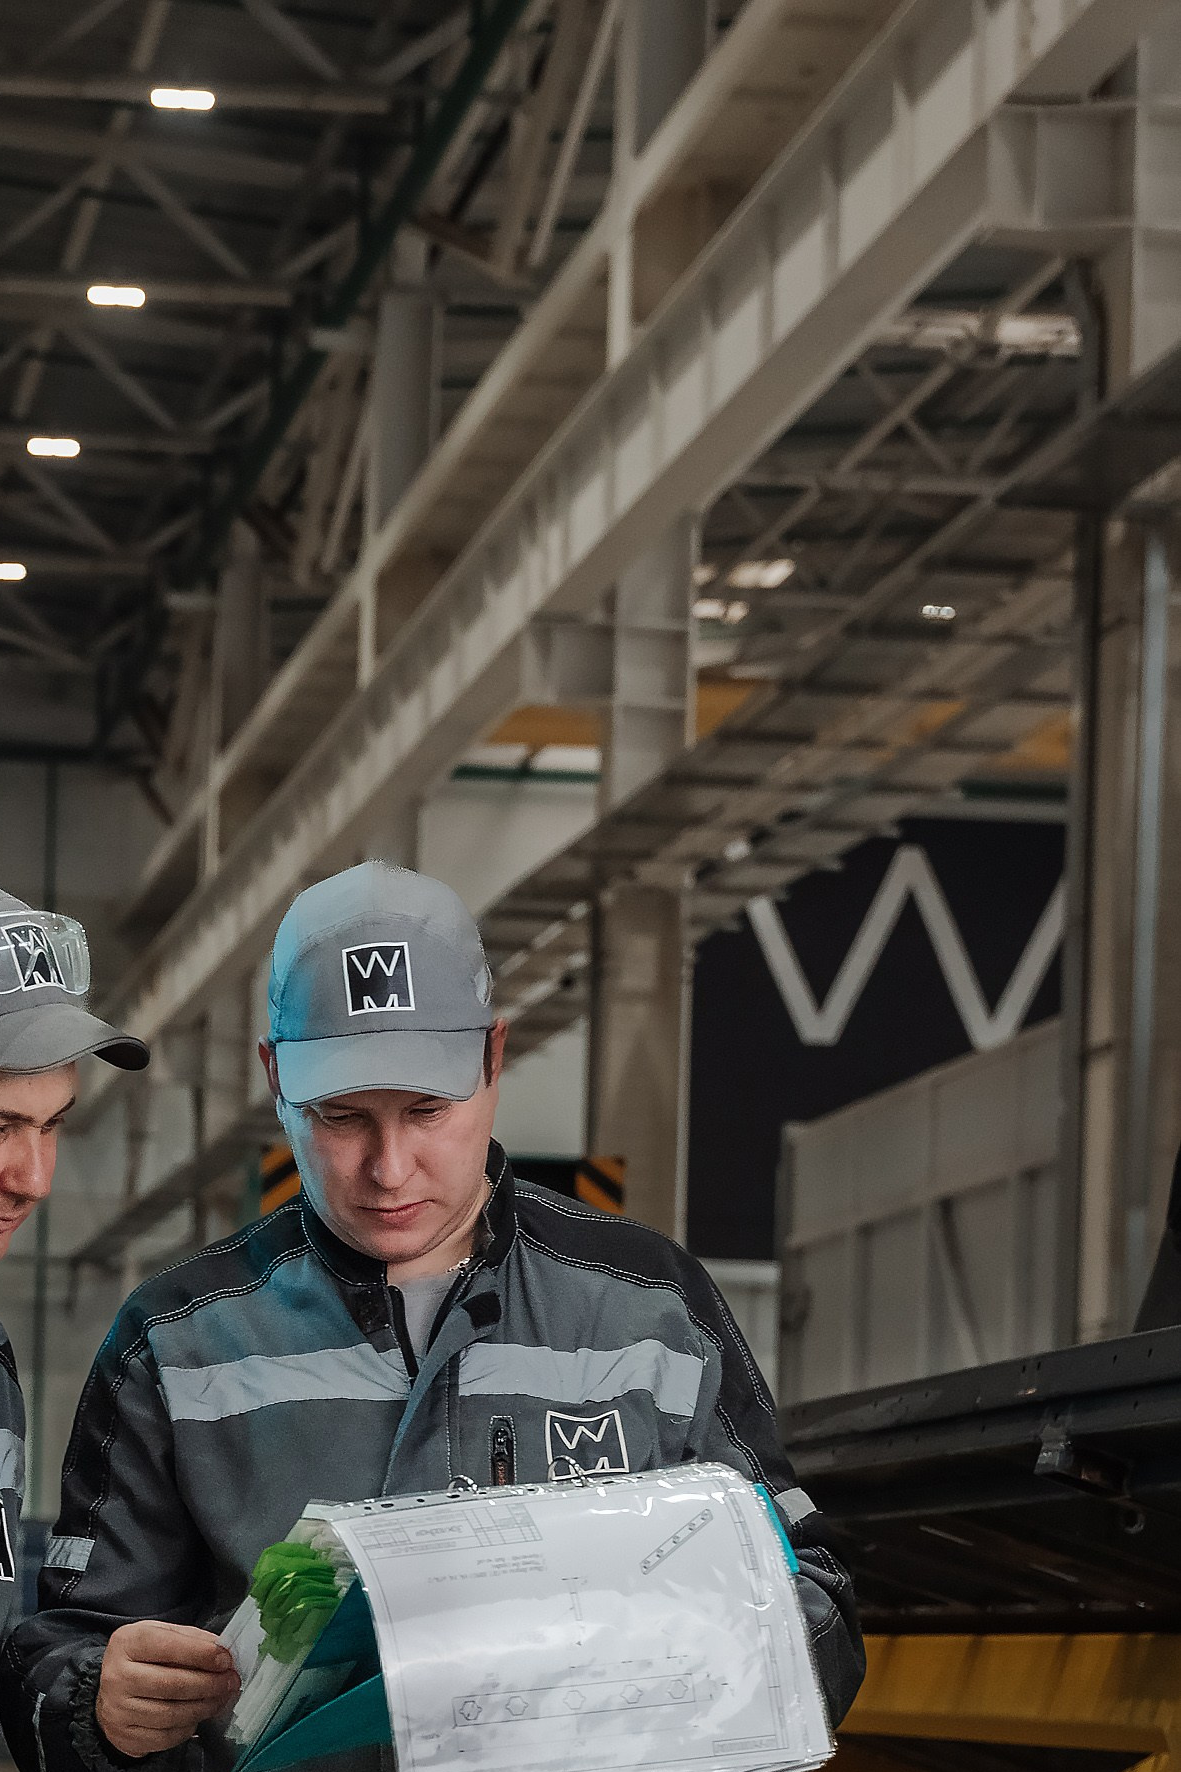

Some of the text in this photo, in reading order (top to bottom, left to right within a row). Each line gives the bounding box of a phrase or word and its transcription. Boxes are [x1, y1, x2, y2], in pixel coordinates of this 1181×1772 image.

[746, 843, 1067, 1050] W
[350, 950, 401, 978] W
[554, 1417, 610, 1449] W
